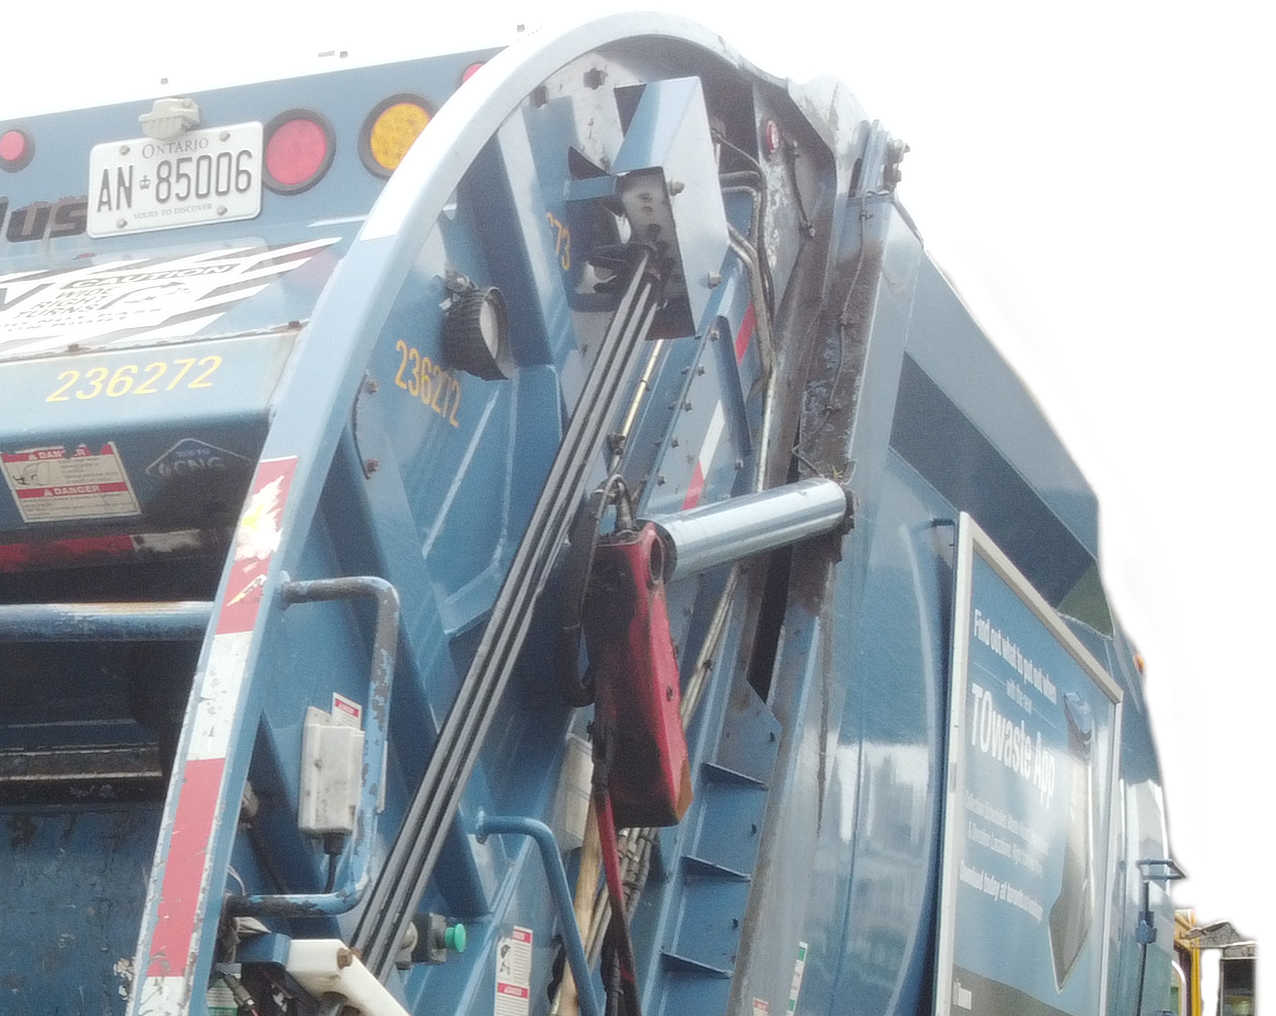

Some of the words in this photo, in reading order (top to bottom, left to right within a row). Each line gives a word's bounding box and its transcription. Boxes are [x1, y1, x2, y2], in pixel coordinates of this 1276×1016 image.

[142, 137, 209, 159] ONTARIO
[96, 164, 134, 213] AN
[155, 149, 253, 204] 85006
[133, 209, 159, 220] YOURS
[161, 208, 174, 216] TO
[174, 202, 213, 215] DISCOVER
[70, 264, 238, 289] CAUTION
[12, 302, 100, 320] TURNS
[30, 294, 111, 310] RIGHT
[45, 355, 223, 403] 236272
[394, 339, 462, 428] 236272
[53, 485, 101, 495] DANGER
[1032, 730, 1056, 810] App
